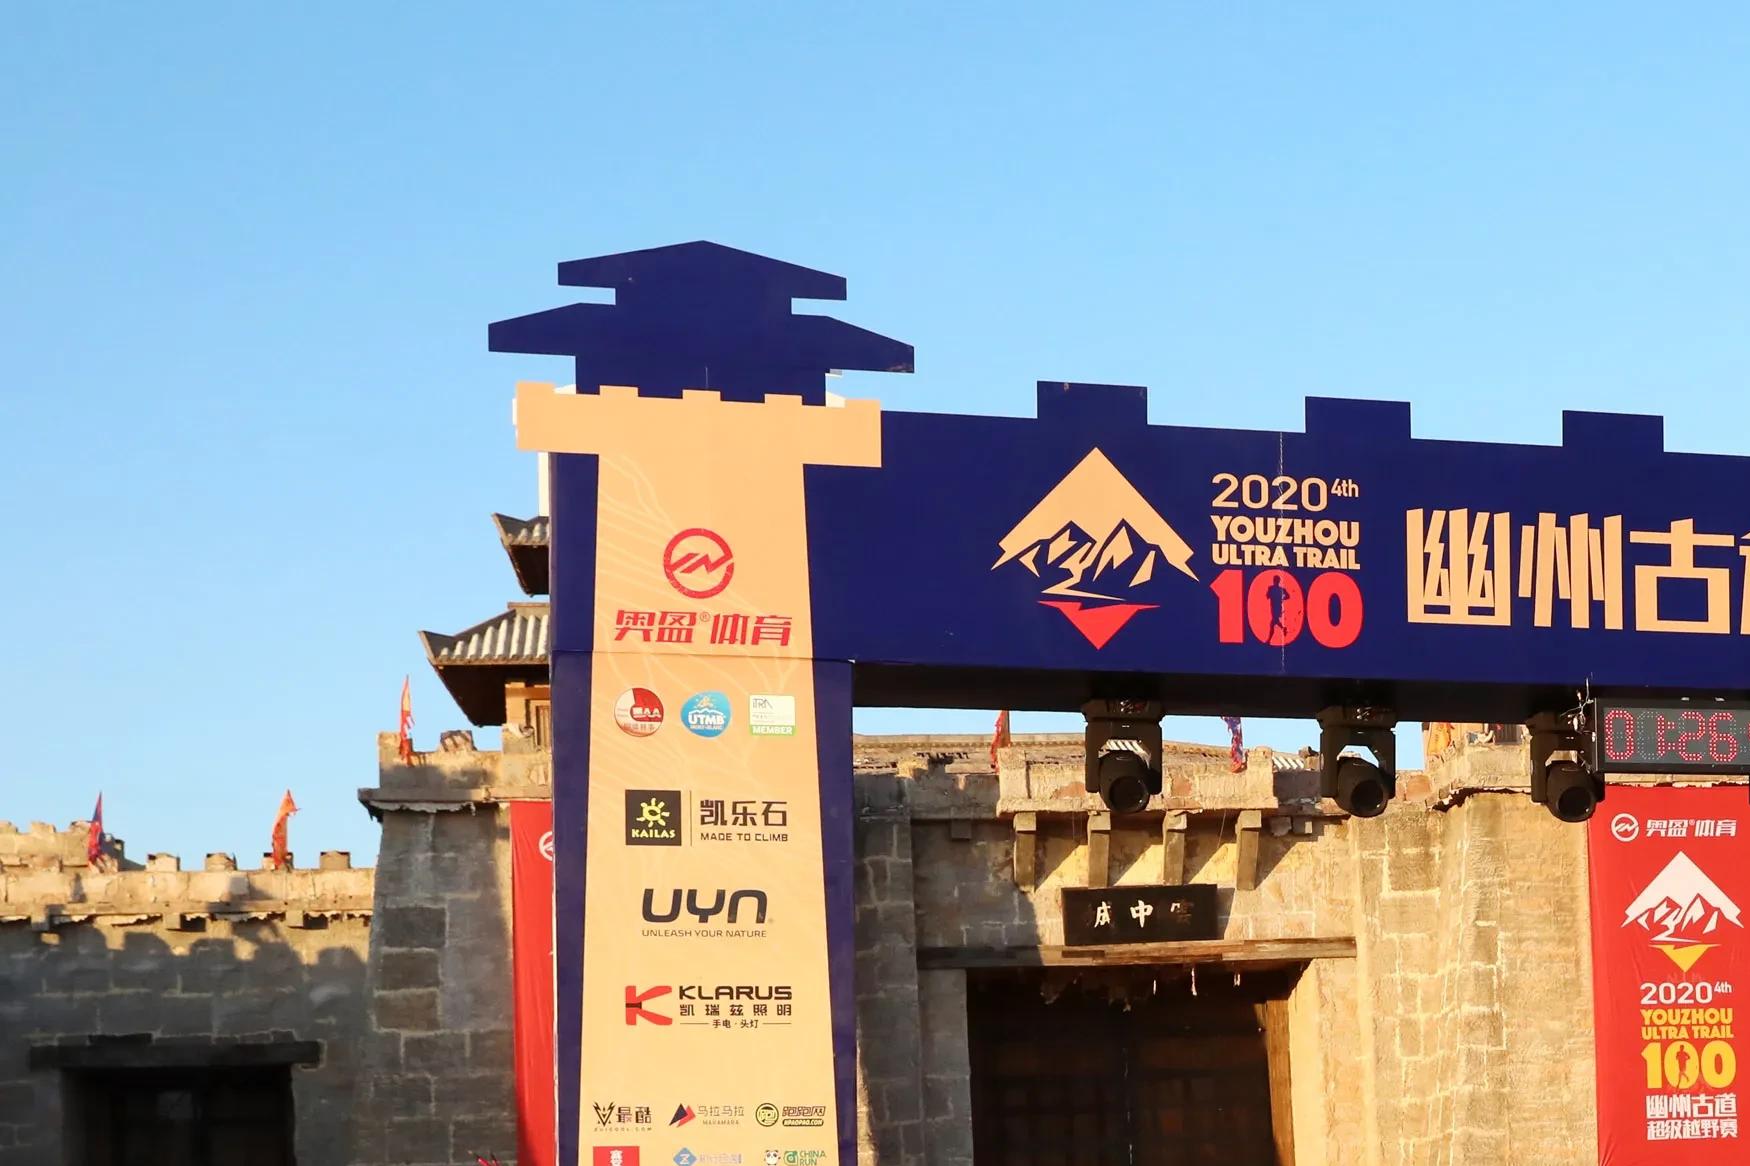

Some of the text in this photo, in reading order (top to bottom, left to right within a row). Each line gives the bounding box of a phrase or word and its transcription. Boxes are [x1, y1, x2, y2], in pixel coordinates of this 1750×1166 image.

[1211, 472, 1359, 512] 2020 4th
[1210, 515, 1360, 547] YOUZHOU
[1211, 543, 1361, 571] ULTRA TRAIL
[1209, 568, 1364, 649] 100
[687, 713, 725, 725] UTMB
[752, 725, 793, 735] MEMBER
[699, 799, 788, 828] 凯乐石
[631, 827, 676, 839] KAILAS
[700, 832, 788, 842] MADE TO CLIMB
[641, 929, 767, 938] UNLEASH YOUR NATURE
[678, 985, 793, 1001] KLARUS
[1640, 981, 1732, 1005] 2020 4th
[1640, 1008, 1733, 1026] YOUZHOU
[1641, 1025, 1734, 1040] ULTRA TRAIL
[1641, 1041, 1737, 1089] 100
[1646, 1093, 1738, 1119] 幽州古道
[1647, 1119, 1739, 1140] 超级越野赛
[799, 1150, 827, 1159] CHINA
[799, 1157, 818, 1166] RUN
